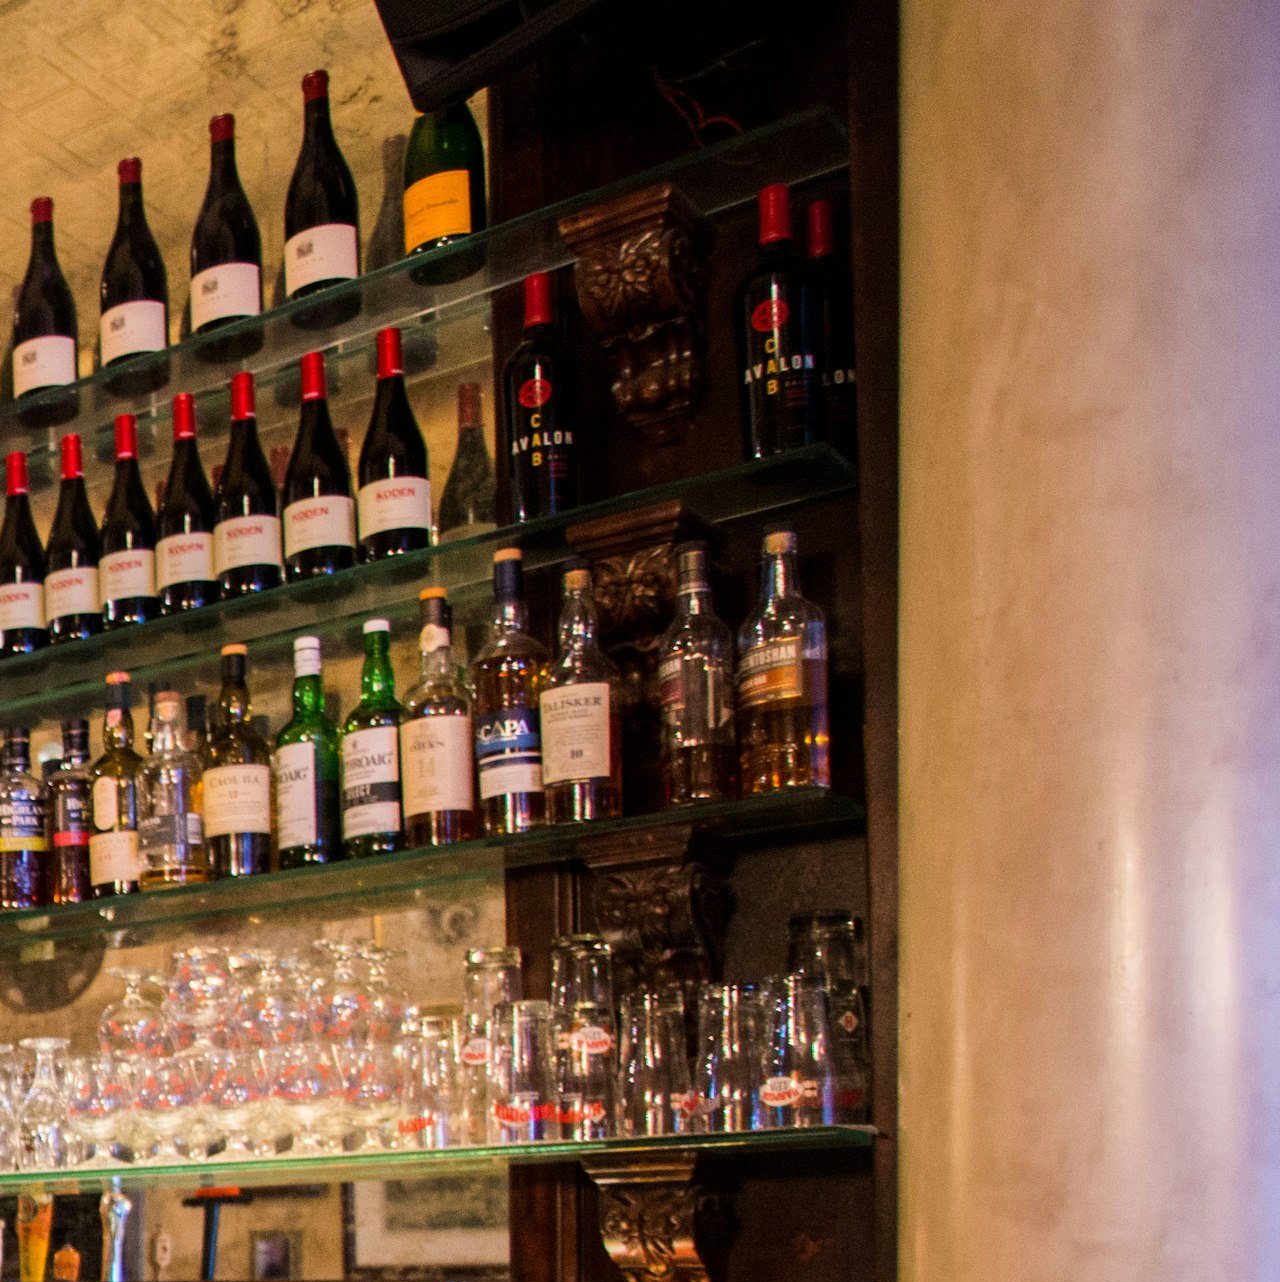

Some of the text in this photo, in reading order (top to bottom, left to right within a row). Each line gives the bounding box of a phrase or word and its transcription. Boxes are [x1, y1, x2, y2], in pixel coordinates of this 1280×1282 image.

[744, 354, 815, 385] AVALON
[511, 430, 573, 457] AVALON
[543, 696, 602, 714] TALISKER
[478, 718, 531, 742] CAPA
